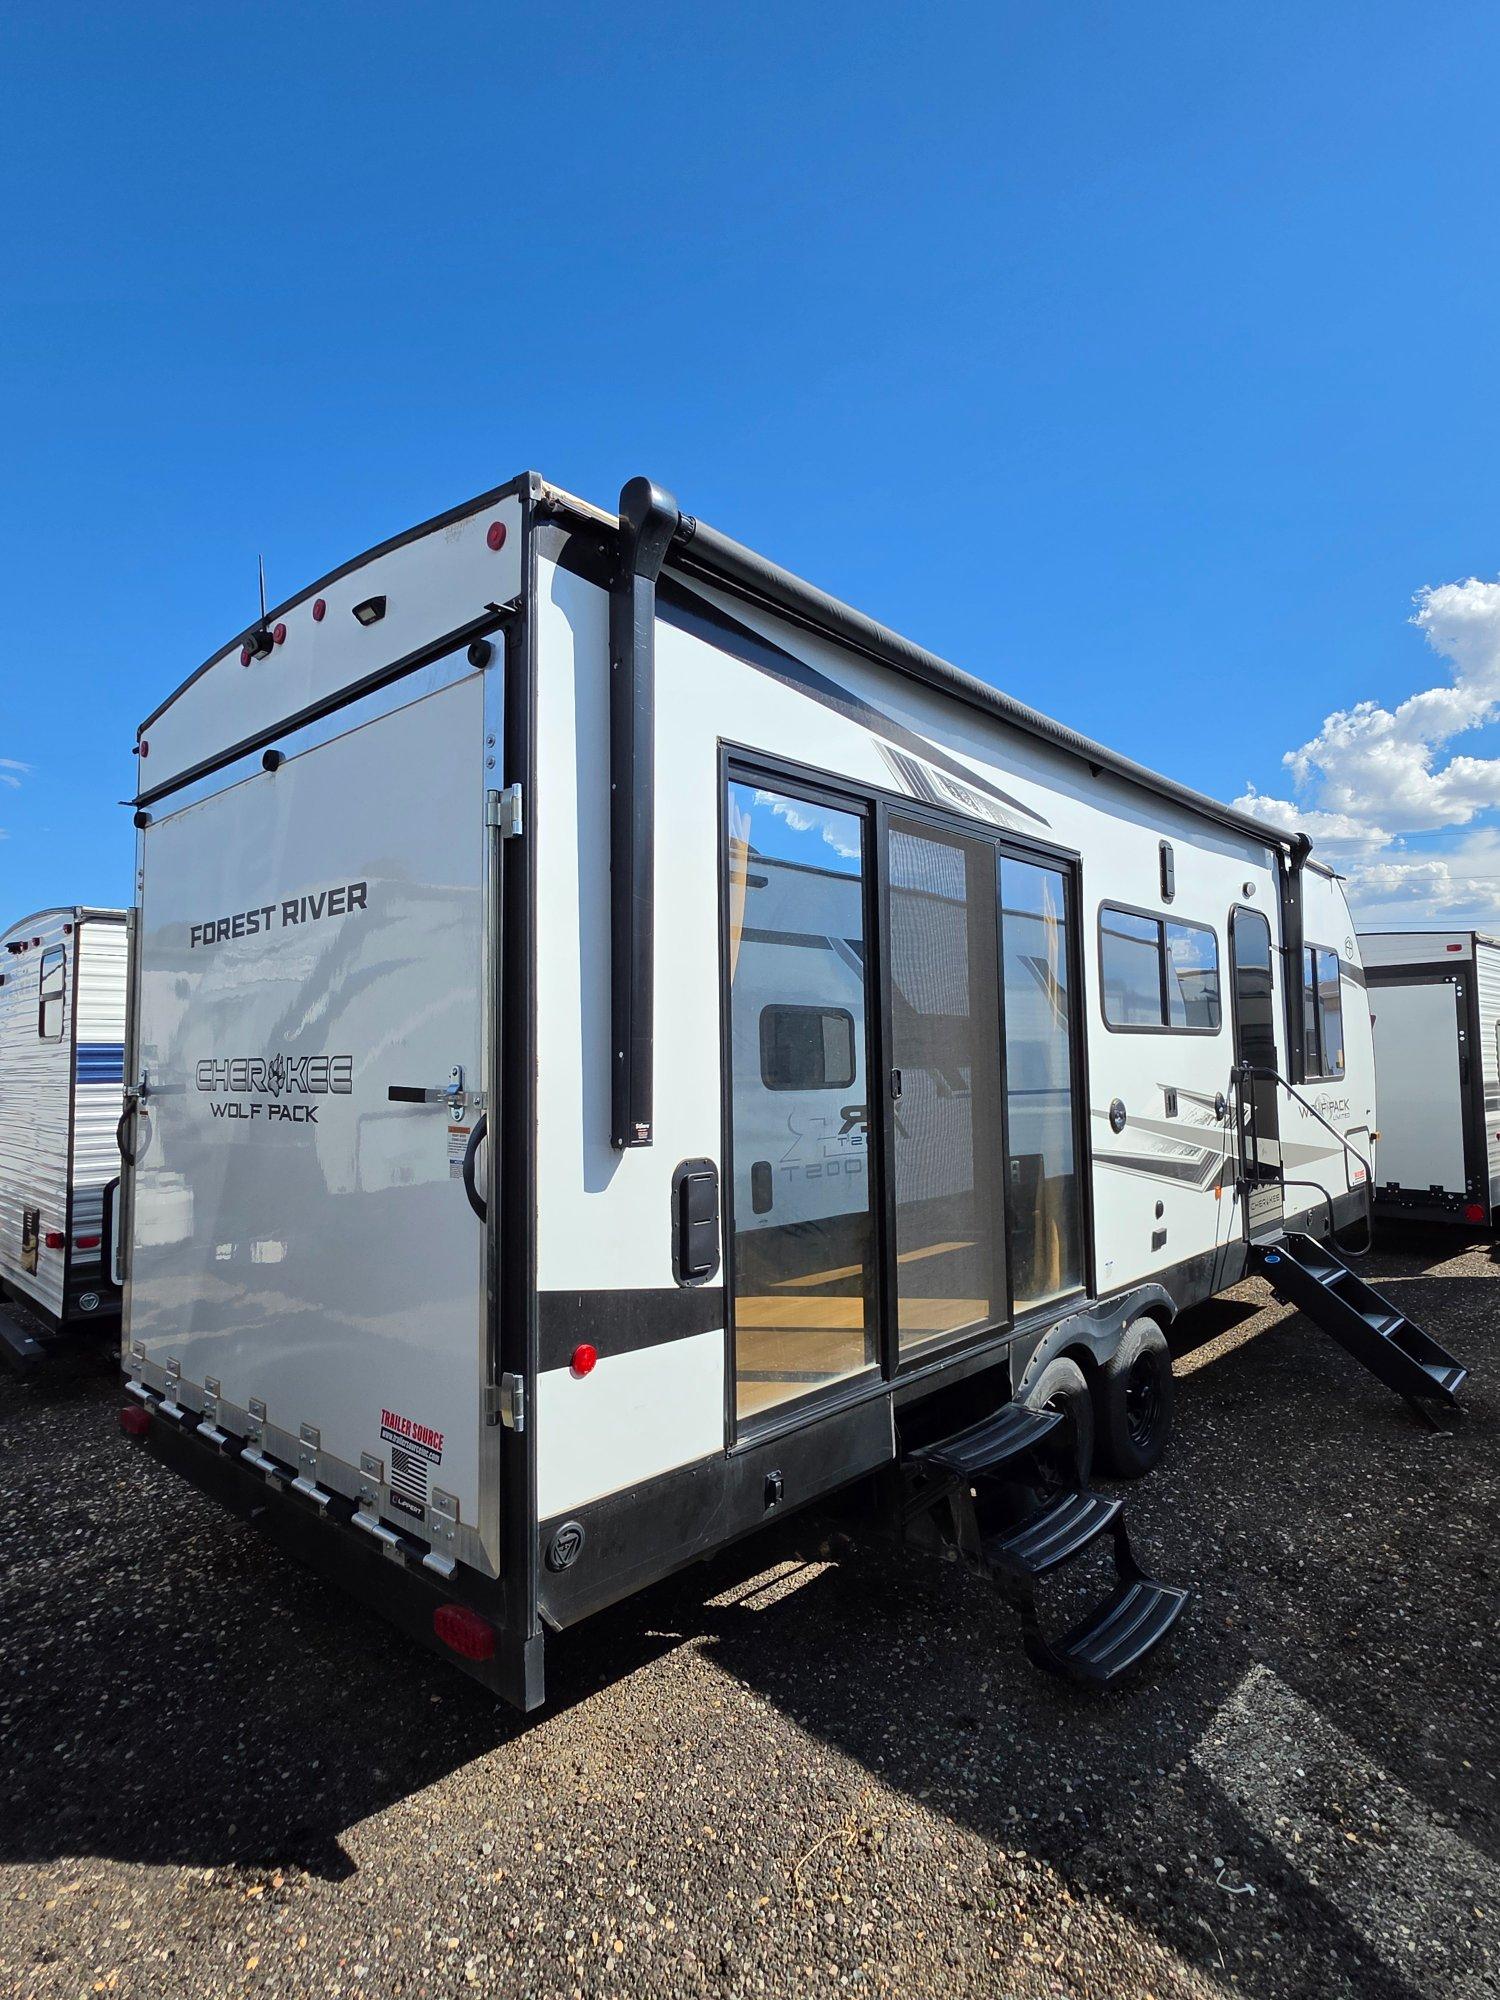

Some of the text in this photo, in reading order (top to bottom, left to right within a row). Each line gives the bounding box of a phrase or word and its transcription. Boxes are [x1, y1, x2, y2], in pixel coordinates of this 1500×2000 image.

[190, 881, 368, 948] FOREST RIVER
[210, 1102, 319, 1123] WOLF PACK
[1329, 1098, 1351, 1114] PACK
[381, 1409, 444, 1452] TRAILER SOURCE
[397, 1497, 422, 1515] LIPPERT
